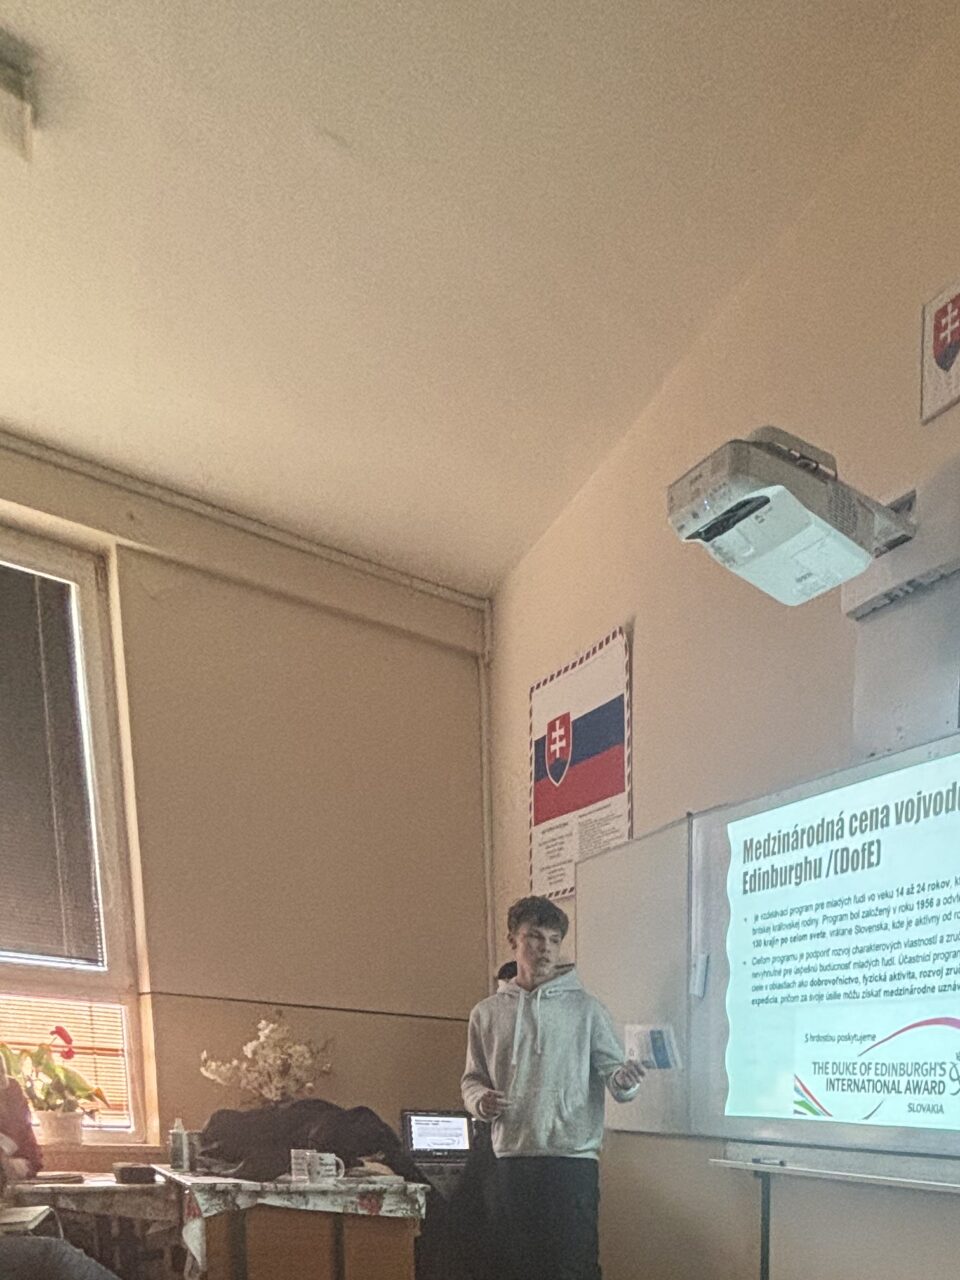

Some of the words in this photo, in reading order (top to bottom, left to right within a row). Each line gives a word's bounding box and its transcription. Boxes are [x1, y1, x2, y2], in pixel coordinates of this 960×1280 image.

[743, 811, 845, 865] Medzinárodná
[849, 803, 891, 837] cena
[742, 856, 823, 896] Edinburghu
[825, 839, 882, 878] /(DofE)
[789, 904, 813, 917] program
[868, 893, 876, 902] vo
[877, 890, 894, 900] veku
[895, 886, 904, 897] 14
[906, 883, 915, 895] až
[916, 882, 926, 894] 24
[822, 912, 849, 925] Program
[850, 910, 860, 920] bol
[861, 904, 890, 919] založený
[893, 906, 897, 914] v
[899, 902, 914, 913] roku
[917, 898, 934, 910] 1956
[780, 937, 788, 948] po
[892, 920, 905, 930] kde
[906, 918, 913, 931] je
[942, 910, 952, 921] od
[852, 940, 902, 955] charakterových
[862, 971, 887, 986] fyzická
[919, 967, 944, 979] rozvoj
[837, 1032, 877, 1044] poskytujeme
[812, 1061, 830, 1076] THE
[832, 1061, 857, 1076] DUKE
[859, 1061, 872, 1076] OF
[874, 1061, 947, 1078] EDINBURGH'S
[826, 1077, 903, 1095] INTERNATIONAL
[904, 1079, 946, 1096] AWARD
[908, 1102, 945, 1114] SLOVAKIA
